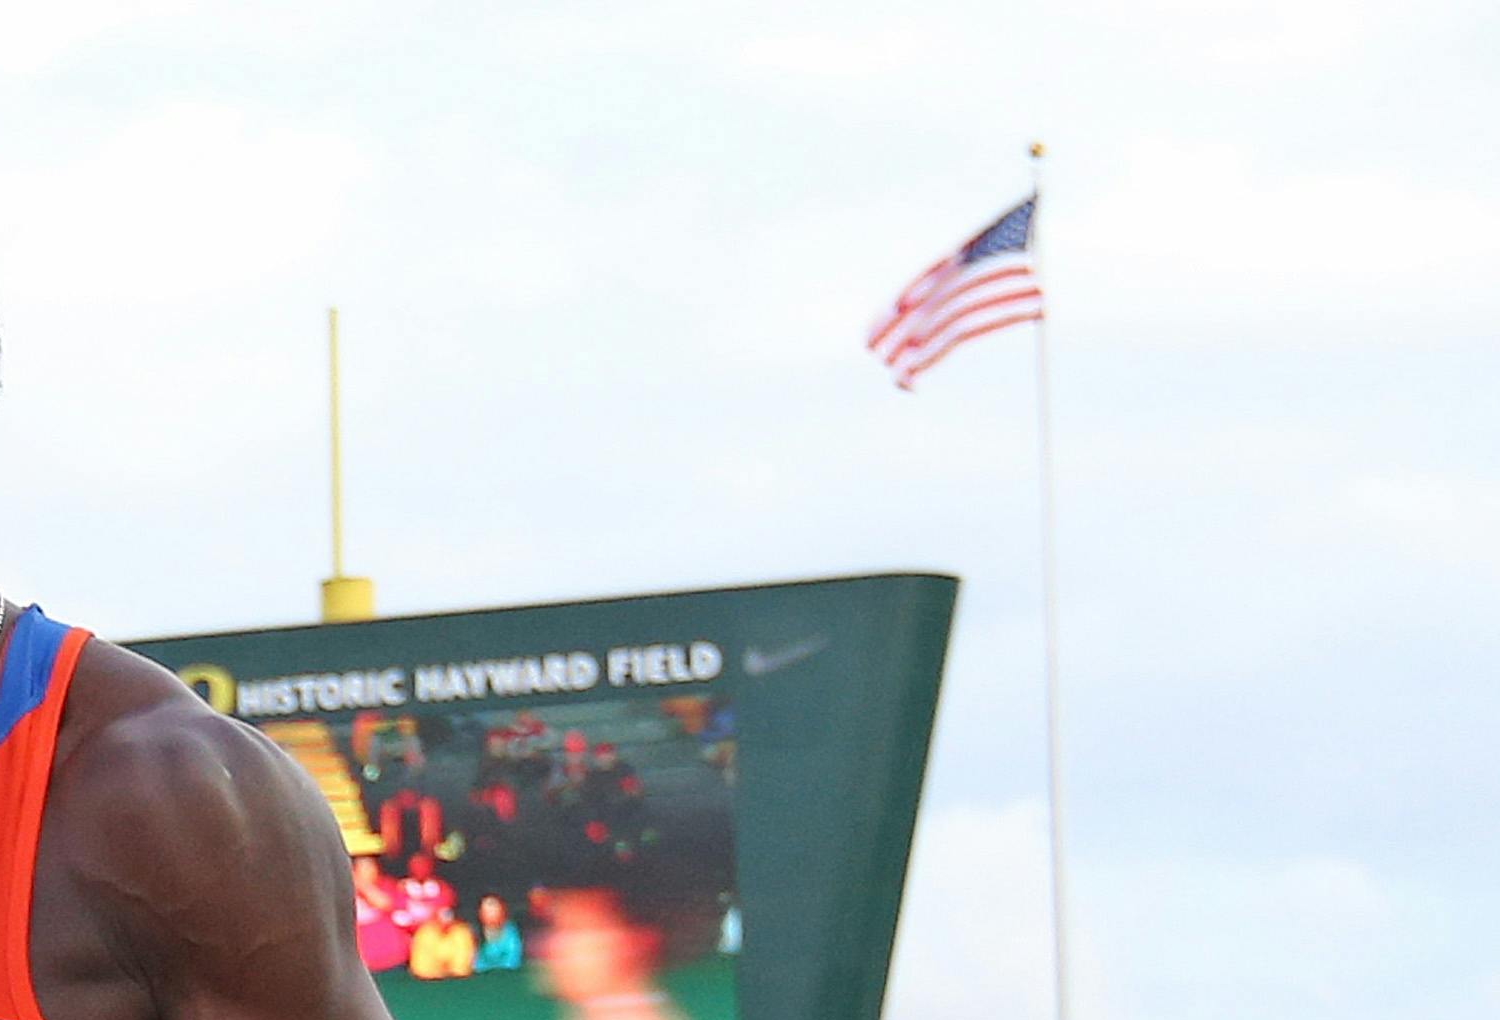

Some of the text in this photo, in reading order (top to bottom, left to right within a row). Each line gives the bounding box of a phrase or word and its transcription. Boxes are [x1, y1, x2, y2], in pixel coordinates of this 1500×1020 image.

[237, 641, 723, 716] HISTORIC HAYWARD FIELD
